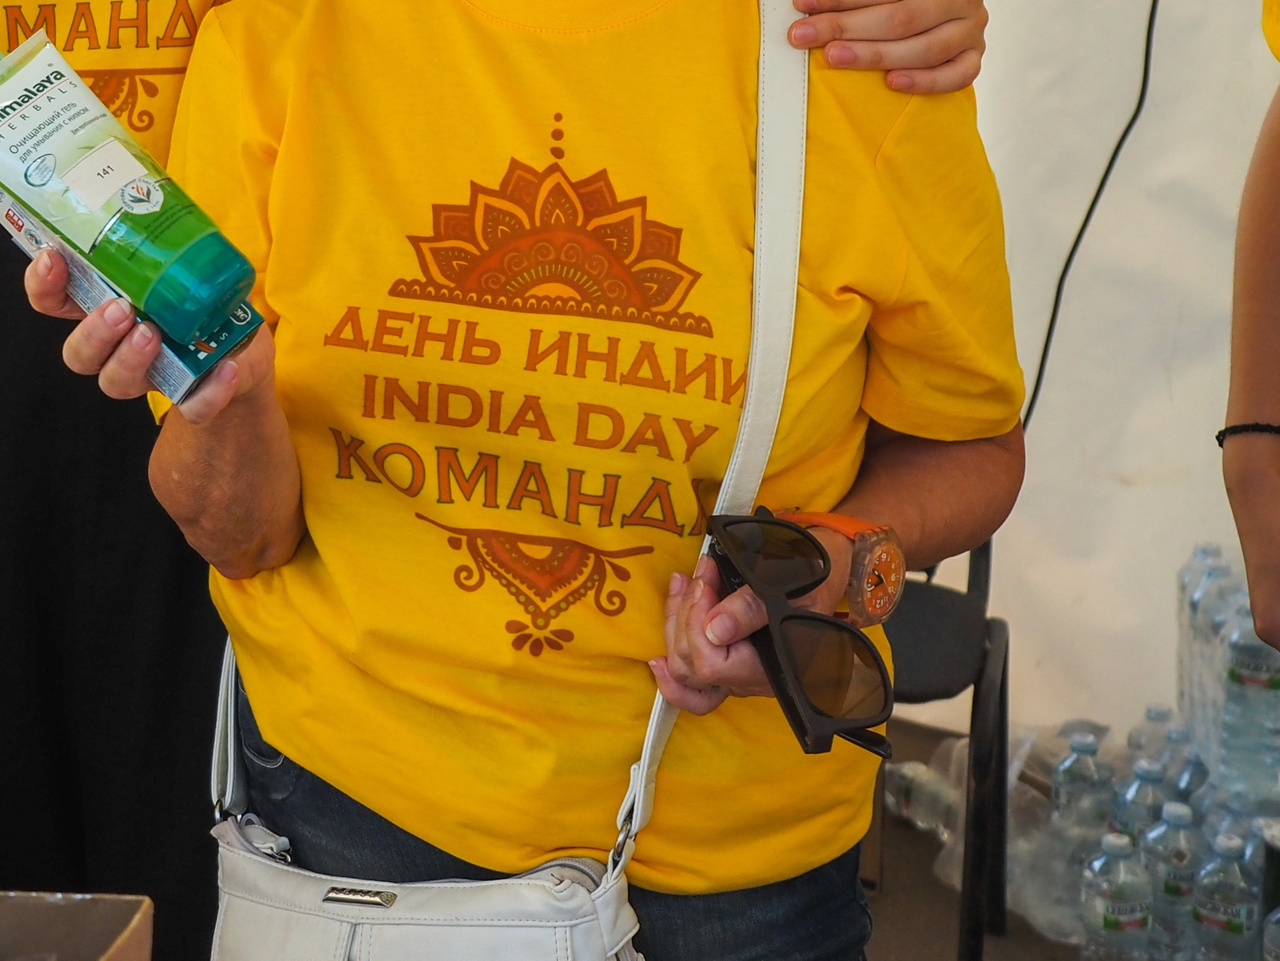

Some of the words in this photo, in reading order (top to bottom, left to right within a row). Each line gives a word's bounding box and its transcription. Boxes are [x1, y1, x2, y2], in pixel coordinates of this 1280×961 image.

[9, 110, 62, 154] Очищающий
[96, 165, 115, 179] 141
[323, 306, 502, 366] ДЕНЬ
[523, 328, 748, 410] ИНДИИ
[362, 374, 556, 442] INDIA
[573, 402, 720, 464] DAY
